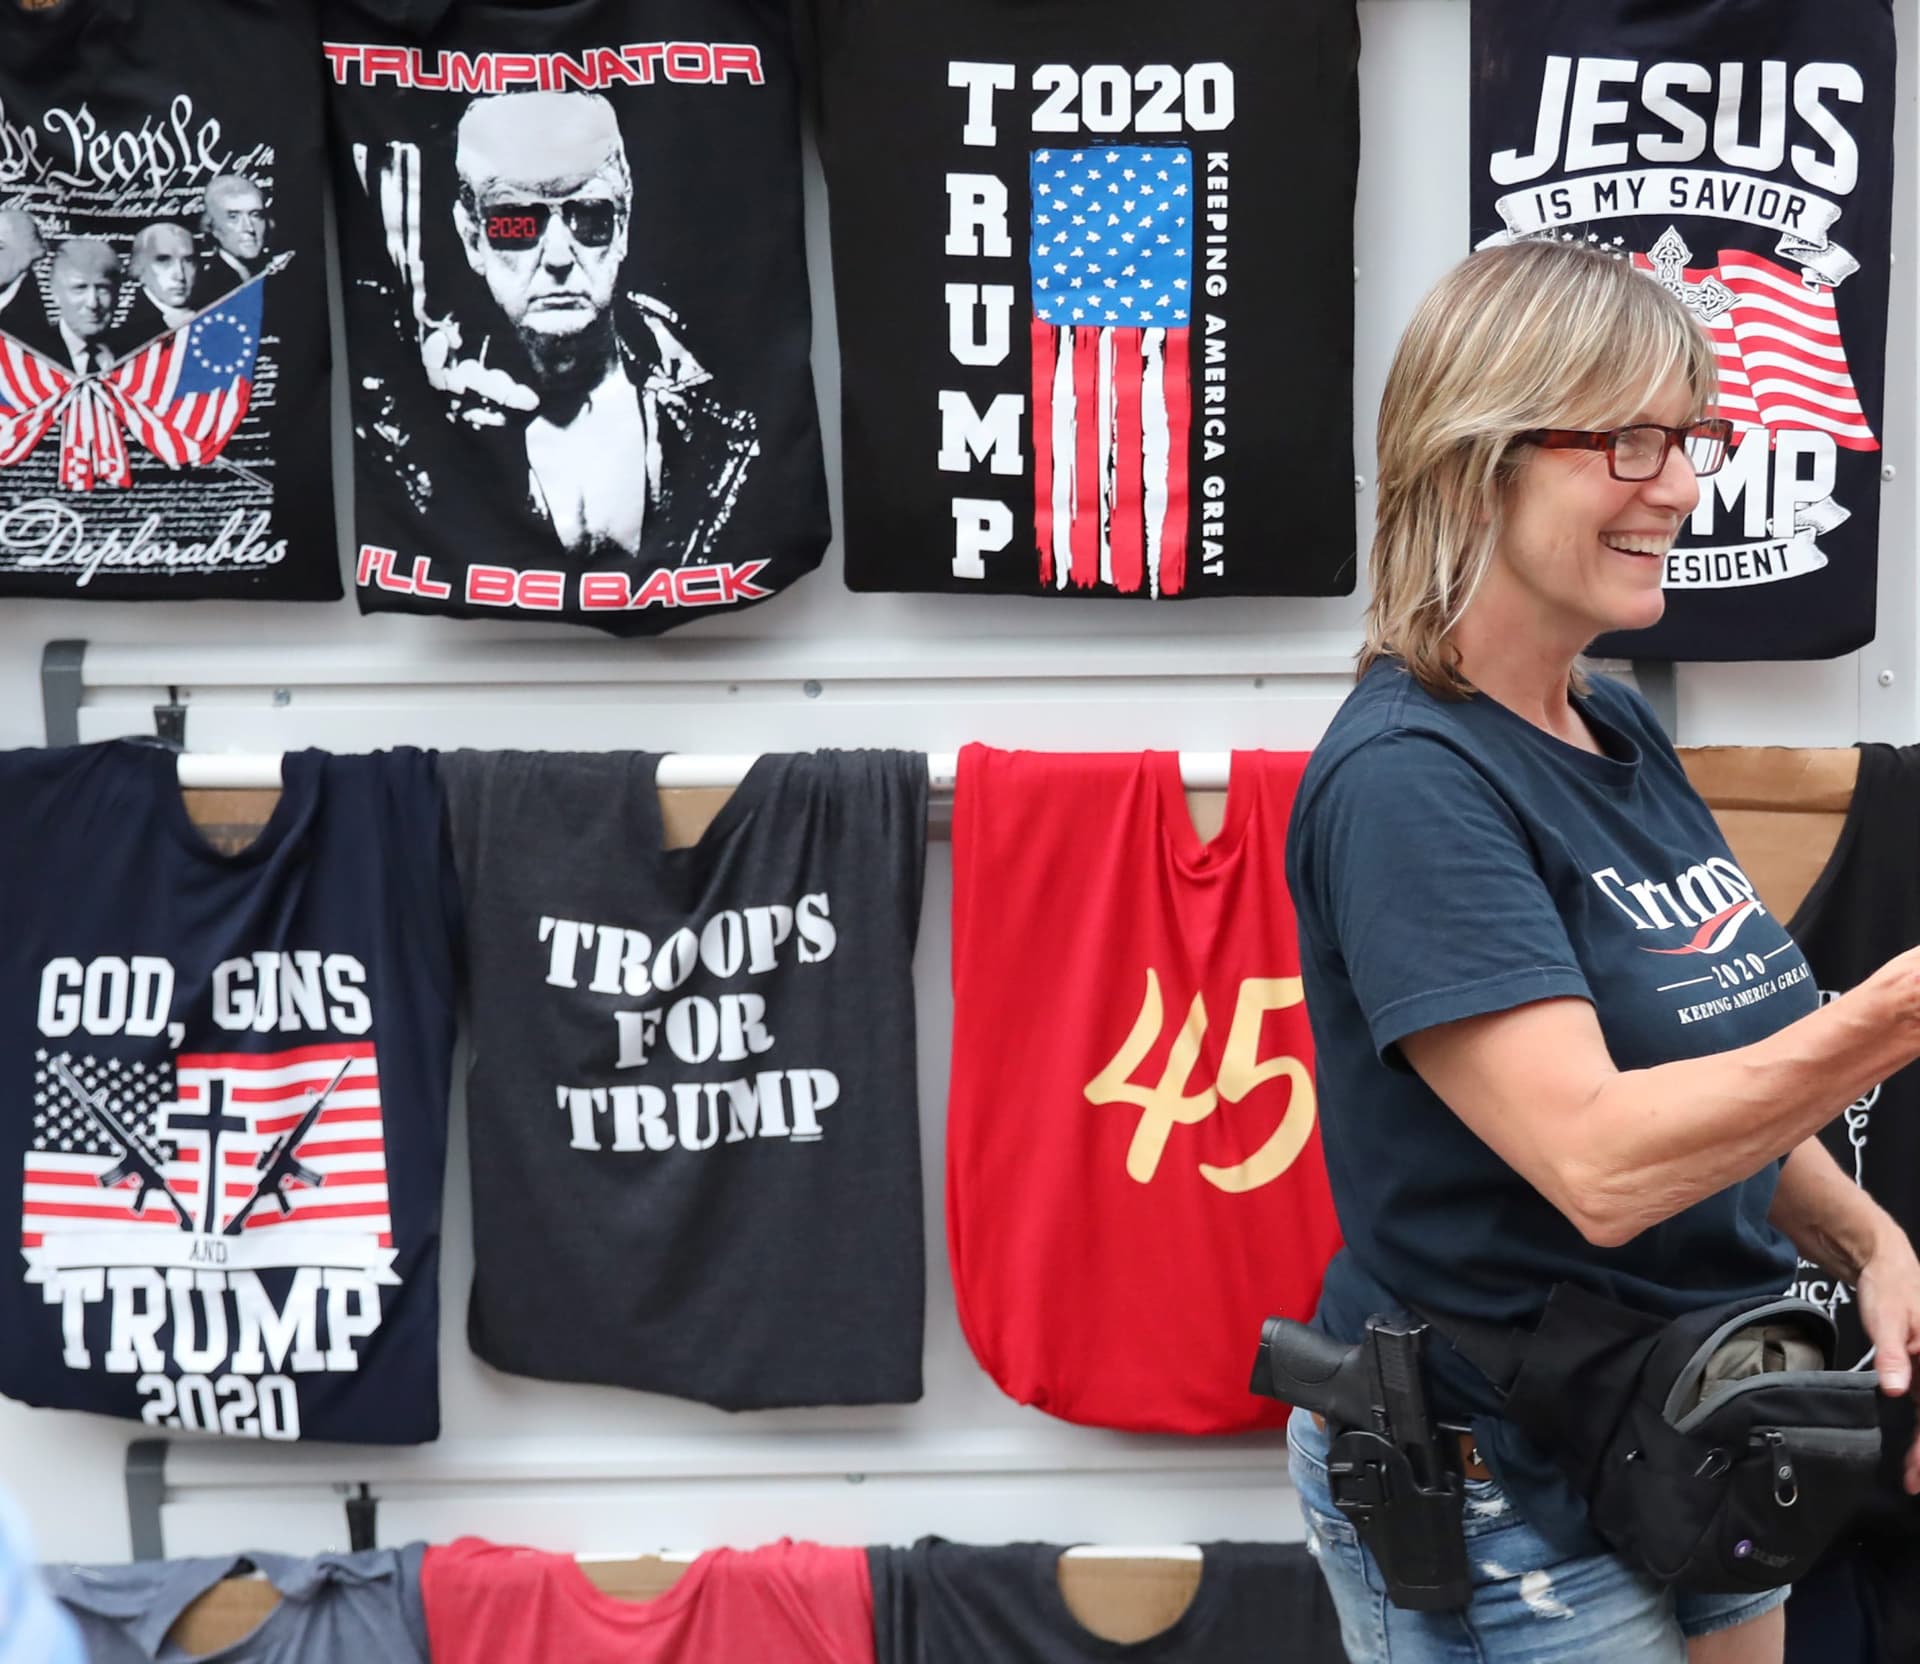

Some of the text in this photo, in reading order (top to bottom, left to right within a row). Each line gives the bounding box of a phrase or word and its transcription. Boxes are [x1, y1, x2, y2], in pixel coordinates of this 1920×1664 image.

[322, 41, 764, 95] TRUMPINATOR
[1031, 62, 1235, 133] 2020
[42, 95, 233, 194] People
[1489, 55, 1864, 196] JESUS
[486, 215, 537, 239] 2020
[1535, 176, 1806, 229] IS MY SAVIOR
[938, 61, 1025, 579] TRUMP
[1202, 152, 1230, 577] KEEPING AMERICA GREAT
[0, 498, 288, 587] Deplorables
[356, 544, 776, 611] I'LL BE BACK
[1666, 543, 1788, 583] ESIDENT
[539, 892, 837, 997] TROOPS
[1711, 953, 1766, 989] 2020
[37, 955, 186, 1049] GOD,
[614, 993, 775, 1069] FOR
[1677, 962, 1810, 1025] KEEPING AMERICA GREAT
[556, 1068, 840, 1152] TRUMP
[1083, 967, 1317, 1193] 45
[189, 1239, 228, 1264] AND
[43, 1266, 382, 1374] TRUMP
[136, 1373, 301, 1441] 2020
